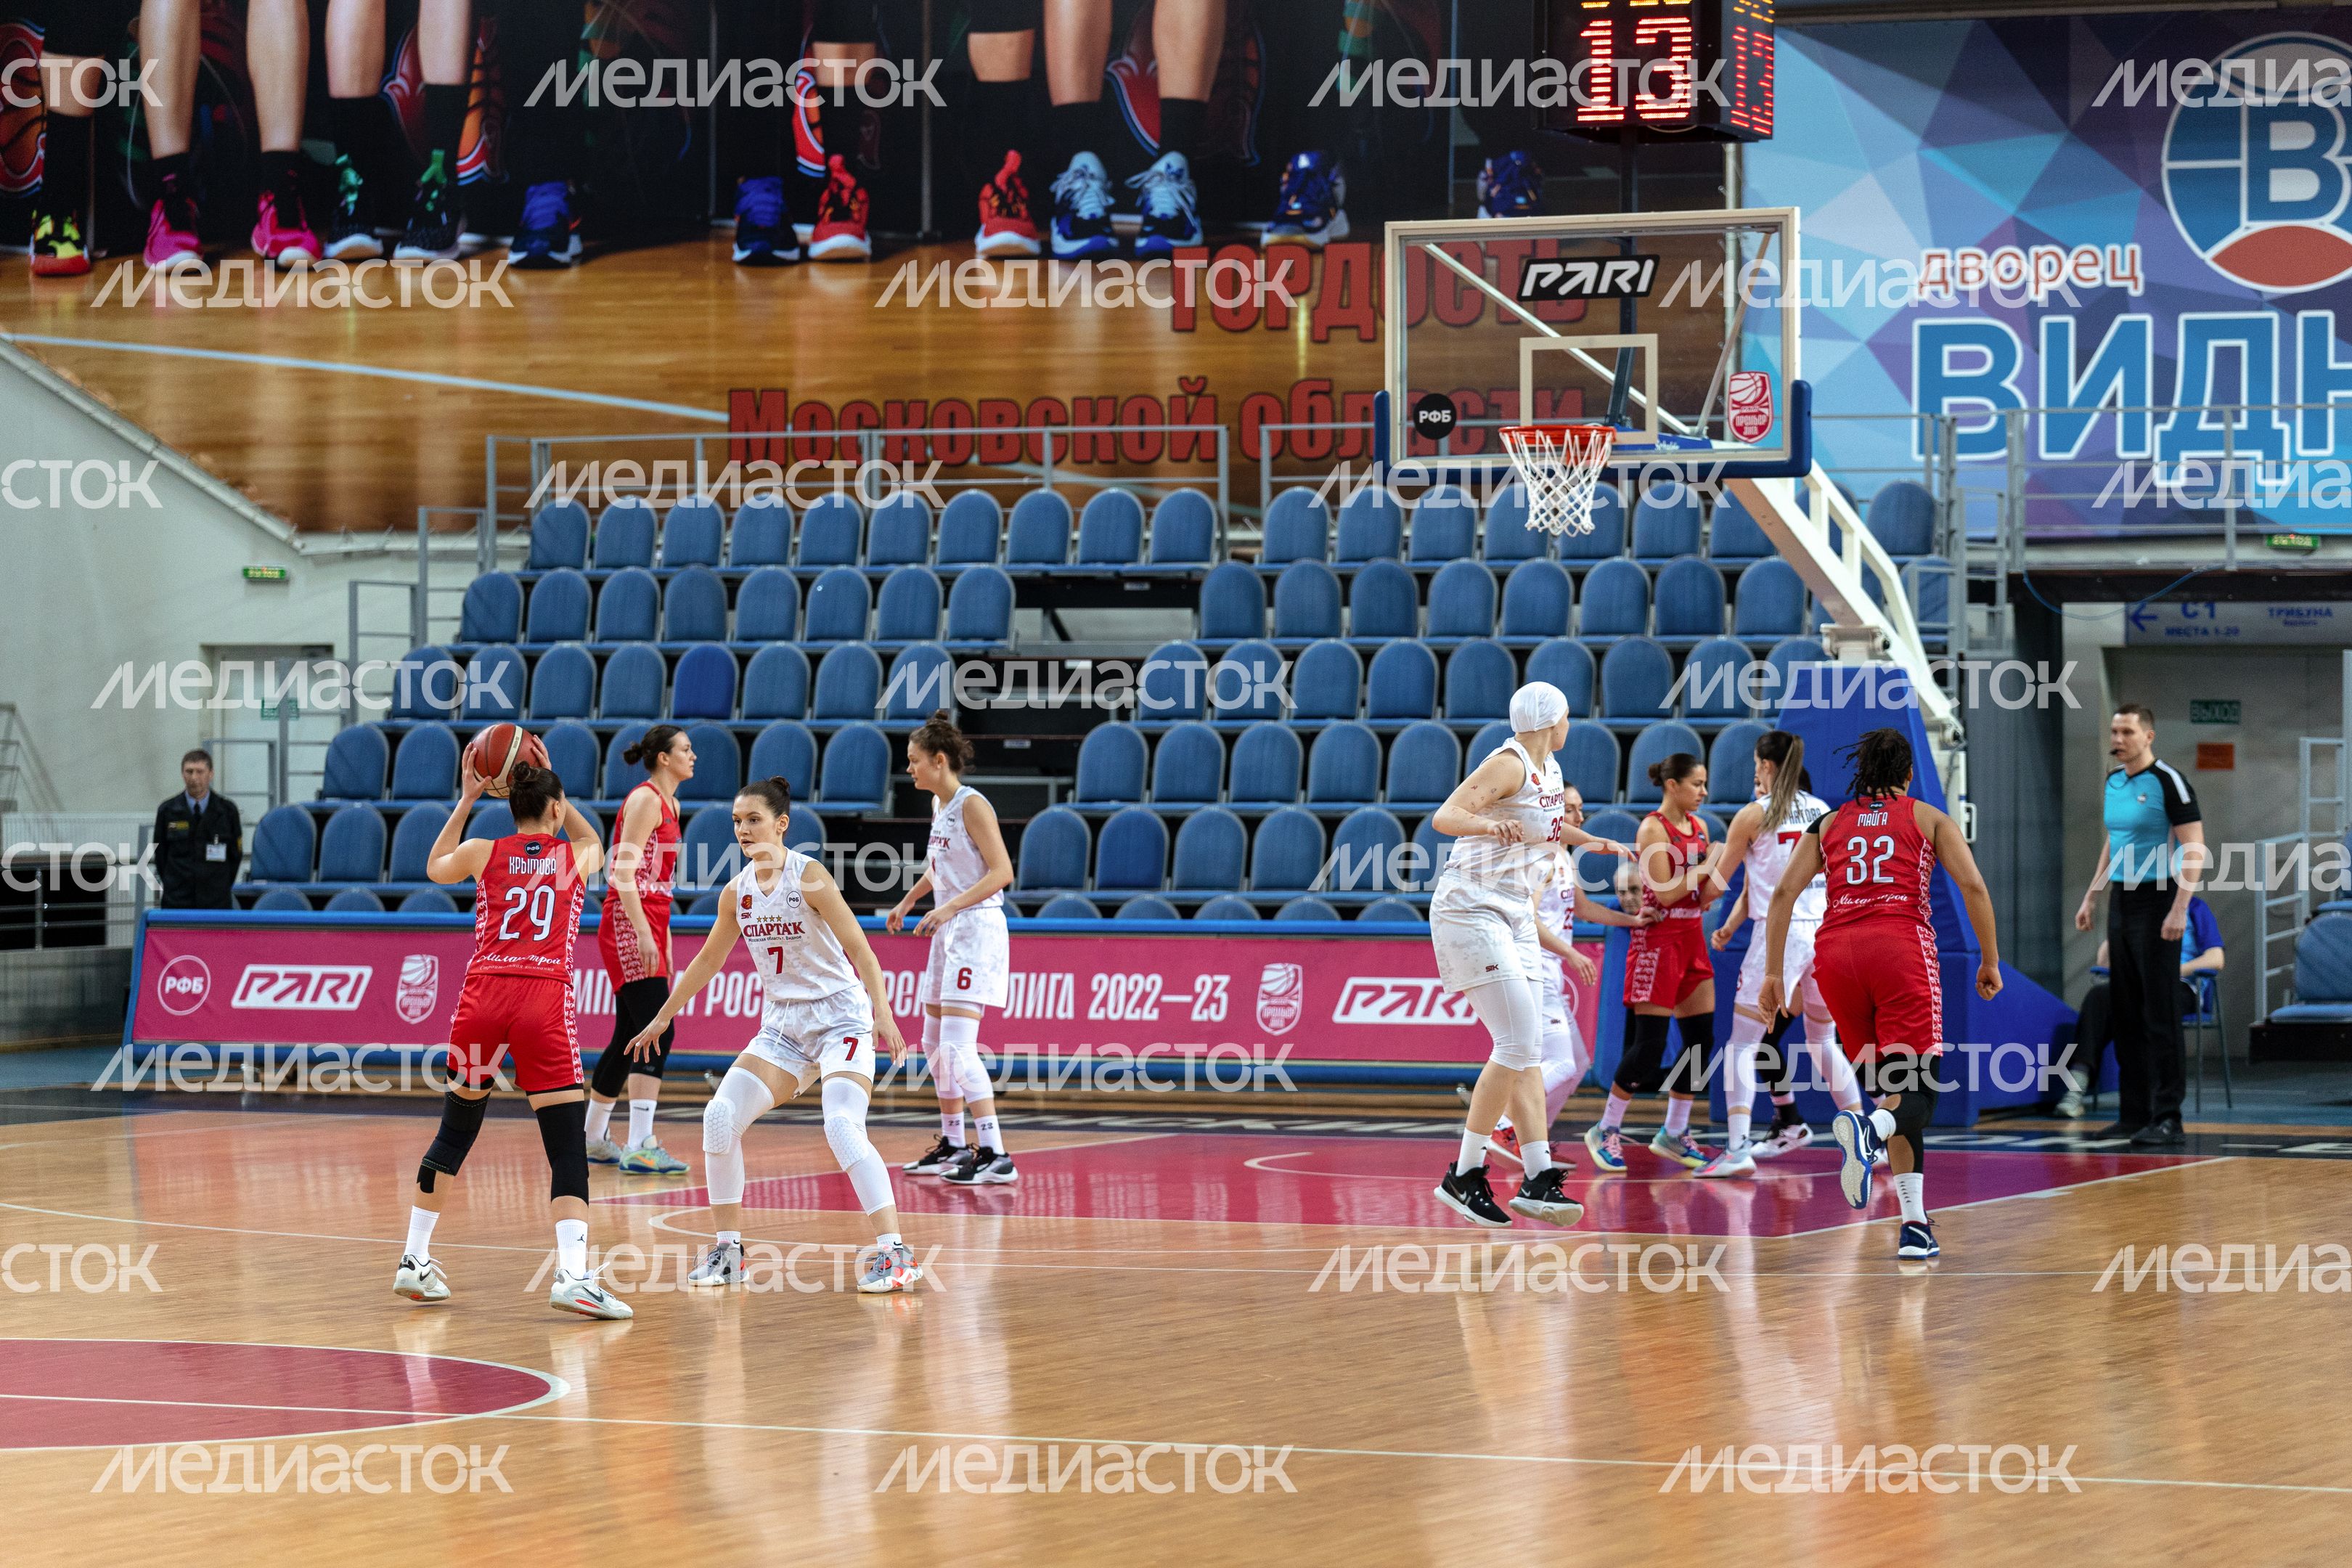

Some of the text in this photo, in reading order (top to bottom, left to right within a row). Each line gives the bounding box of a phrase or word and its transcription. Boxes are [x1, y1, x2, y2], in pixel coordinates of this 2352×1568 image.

[1577, 17, 1692, 121] 13
[1521, 258, 1655, 298] PARI
[1917, 243, 2144, 301] дворец
[728, 376, 1218, 467] Московской
[1418, 409, 1452, 425] РФБ
[509, 856, 557, 875] КРЫМОВА
[1845, 834, 1895, 886] 32
[498, 884, 556, 942] 29
[743, 920, 806, 938] СПАРТАК
[767, 946, 784, 975] 7
[164, 975, 205, 995] РФБ
[238, 971, 366, 1003] PARI
[956, 966, 973, 991] 6
[1339, 983, 1475, 1017] PAR
[843, 1036, 859, 1061] 7
